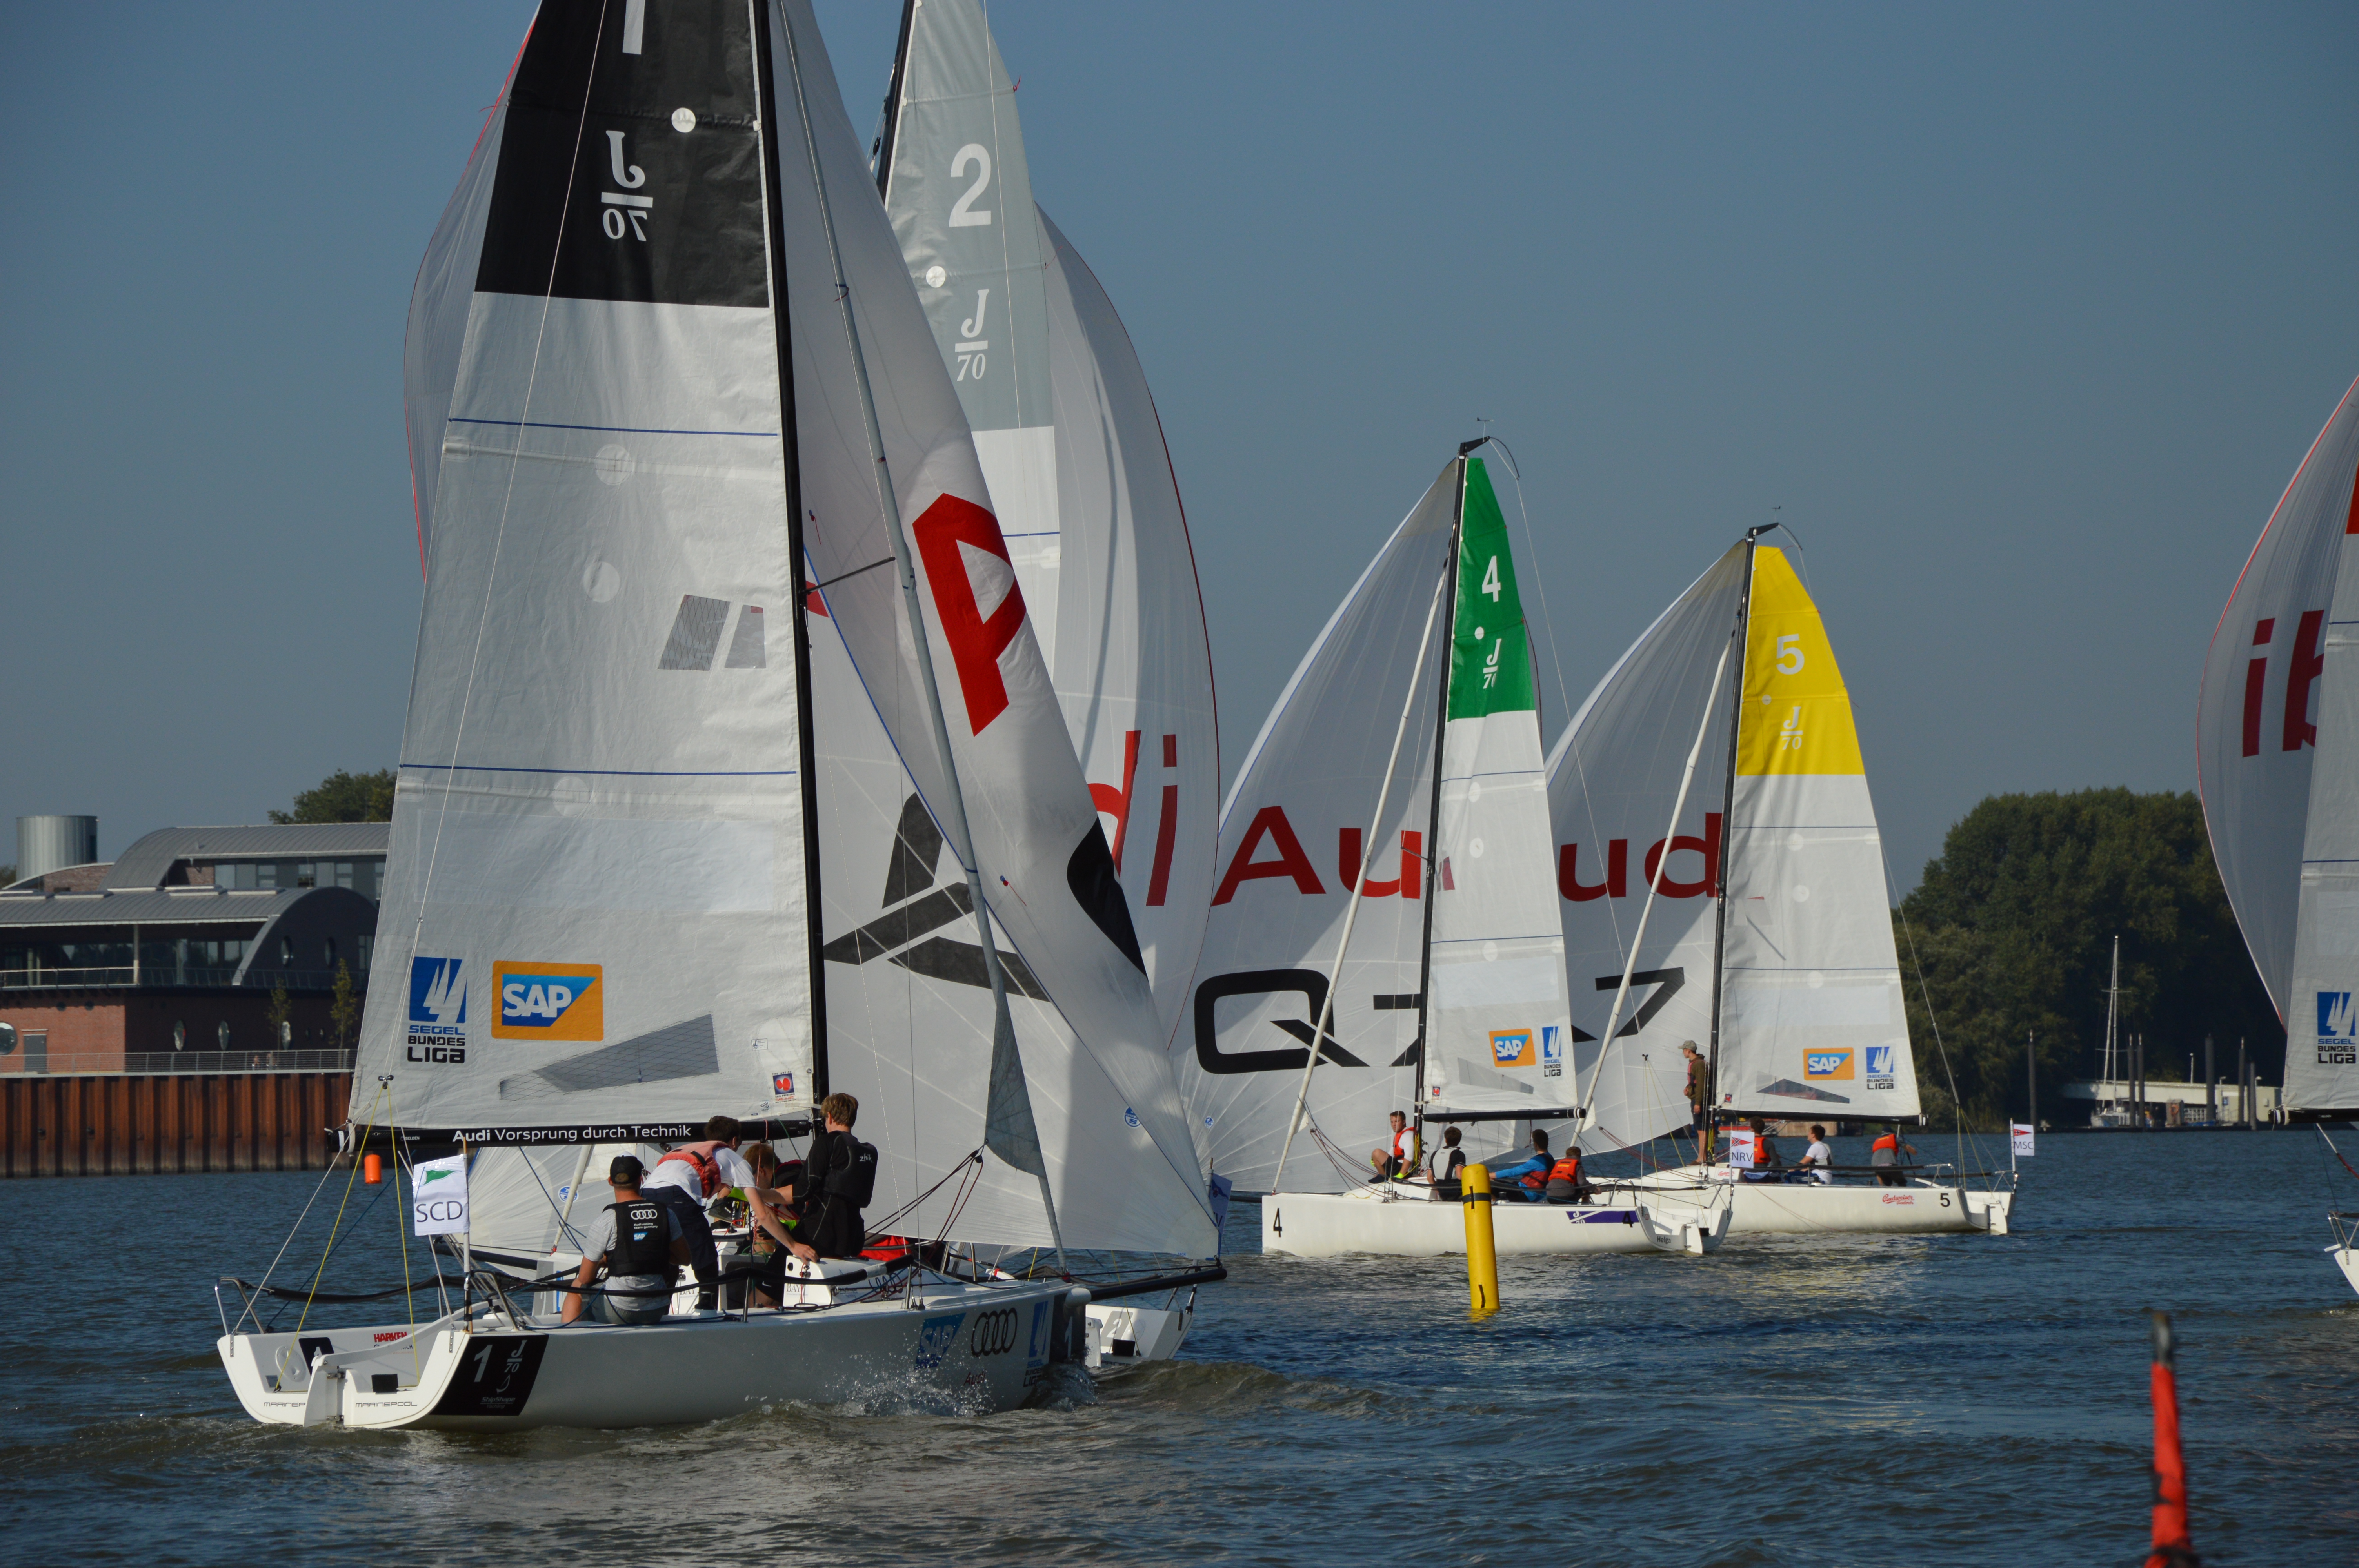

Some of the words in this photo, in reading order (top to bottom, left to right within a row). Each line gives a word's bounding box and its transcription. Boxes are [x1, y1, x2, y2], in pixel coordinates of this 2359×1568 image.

[949, 143, 991, 227] 2
[961, 289, 989, 338] J
[957, 353, 986, 381] 70
[1482, 555, 1501, 602] 4
[1486, 639, 1502, 665] J
[1776, 633, 1805, 675] 5
[1783, 706, 1801, 730] J
[1782, 737, 1802, 750] 70
[503, 983, 572, 1018] SAP
[408, 1025, 465, 1035] SEGEL
[408, 1035, 465, 1046] BUNDES
[1495, 1040, 1523, 1057] SAP
[1808, 1056, 1841, 1071] SAP
[453, 1130, 490, 1142] Audi
[494, 1129, 577, 1142] Vorsprung
[583, 1126, 627, 1138] durch
[631, 1125, 691, 1137] Technik
[2014, 1141, 2033, 1149] MSC
[1732, 1152, 1753, 1161] NRV
[1940, 1193, 1950, 1207] 5
[416, 1201, 463, 1222] SCD
[1622, 1210, 1634, 1228] 4
[1273, 1208, 1282, 1238] 4
[1657, 1236, 1671, 1244] Helga
[1106, 1318, 1122, 1338] 2
[373, 1332, 407, 1343] HARKEN
[511, 1340, 527, 1357] J
[474, 1345, 493, 1382] 1
[504, 1363, 520, 1372] 70
